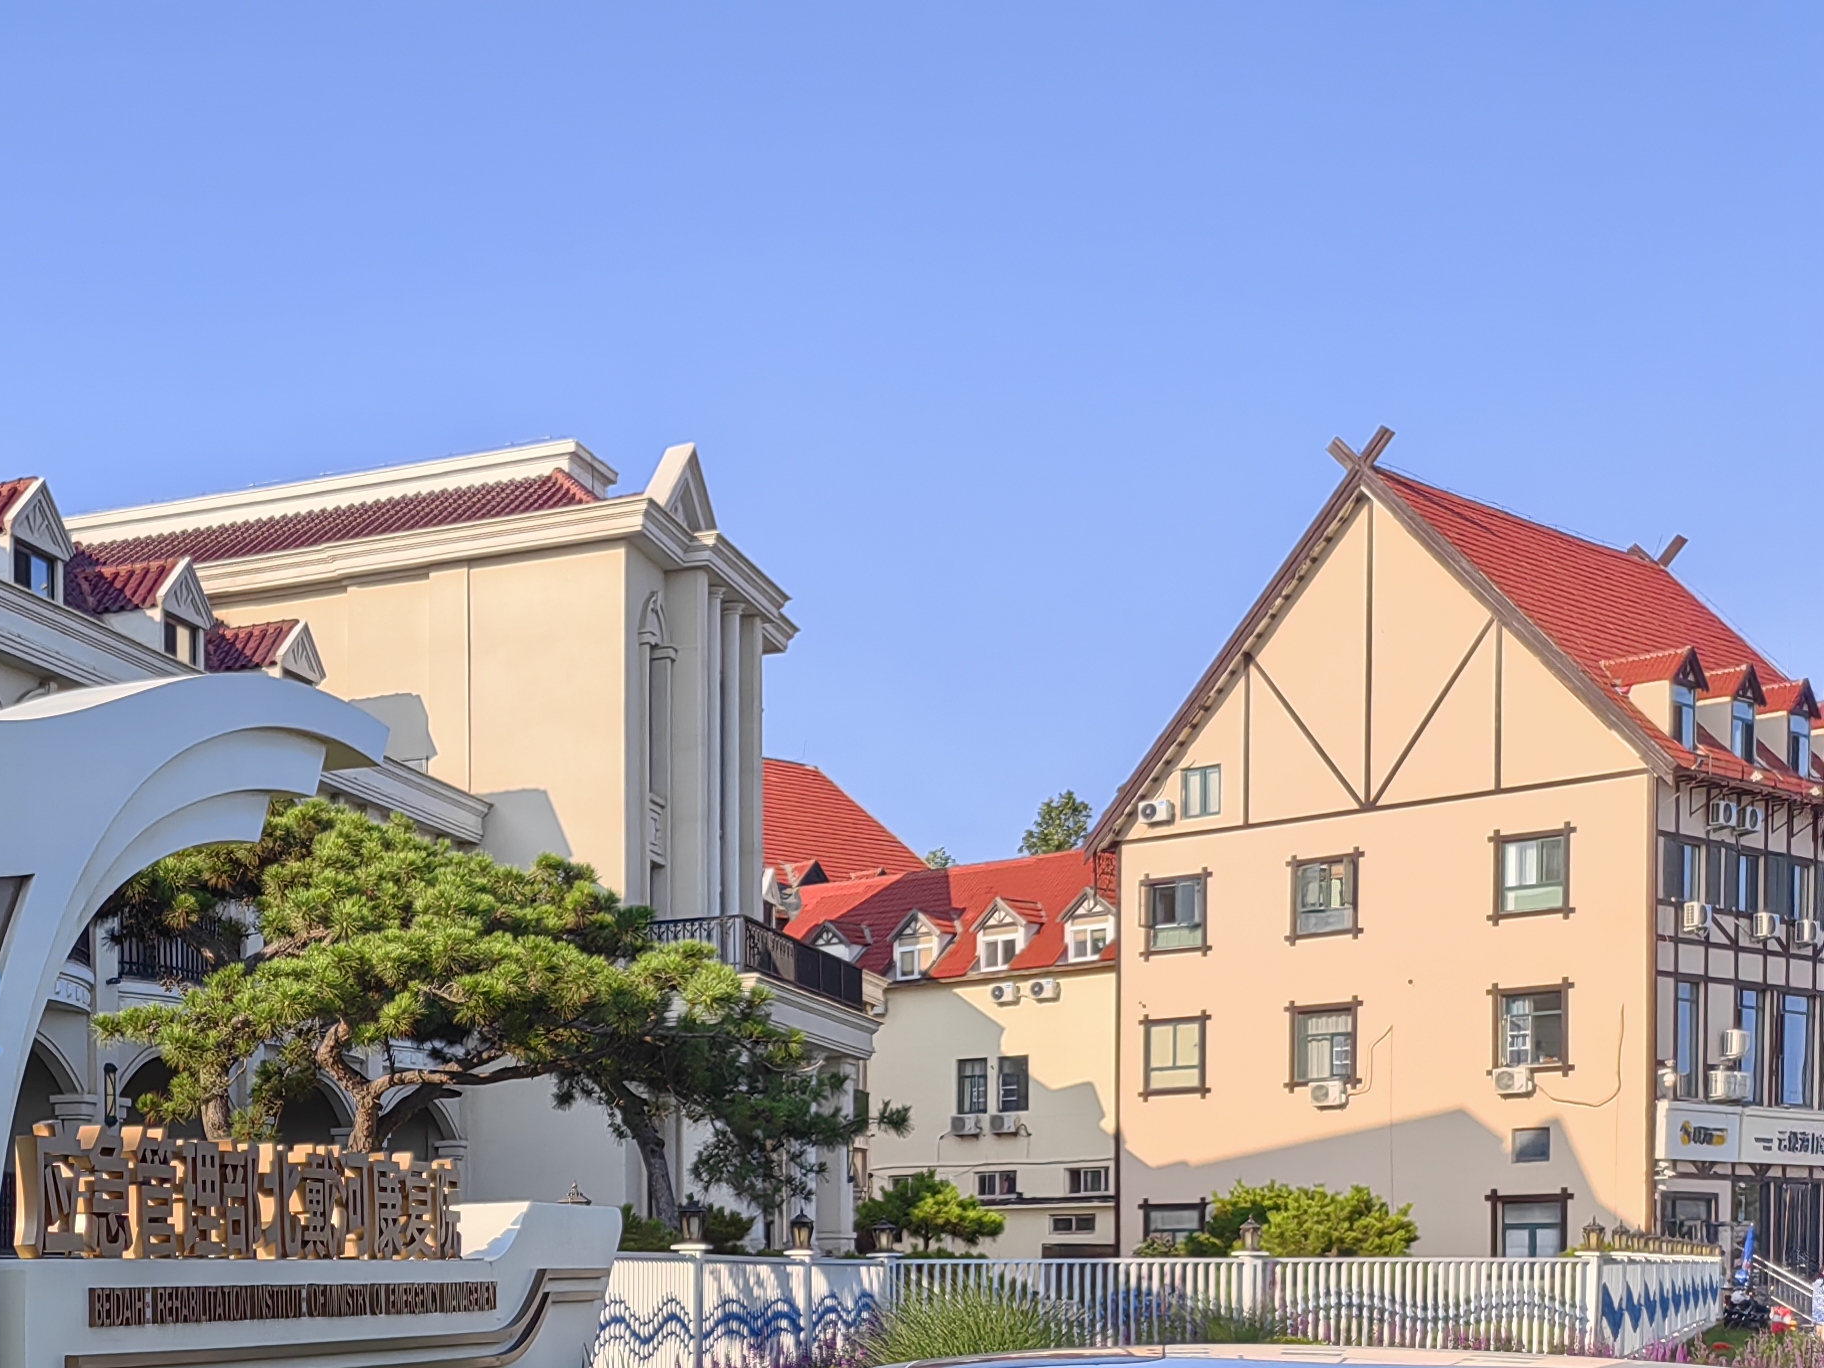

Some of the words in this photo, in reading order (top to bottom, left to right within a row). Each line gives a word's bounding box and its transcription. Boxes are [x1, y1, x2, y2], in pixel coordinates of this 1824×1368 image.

[16, 1120, 462, 1259] 应急管理部北戴河康复院
[157, 1285, 251, 1324] REHABILITATION
[311, 1284, 325, 1317] OF
[326, 1283, 369, 1316] MINISTRY
[389, 1282, 440, 1315] EMERGENCY
[443, 1281, 498, 1313] MANAGEMENT
